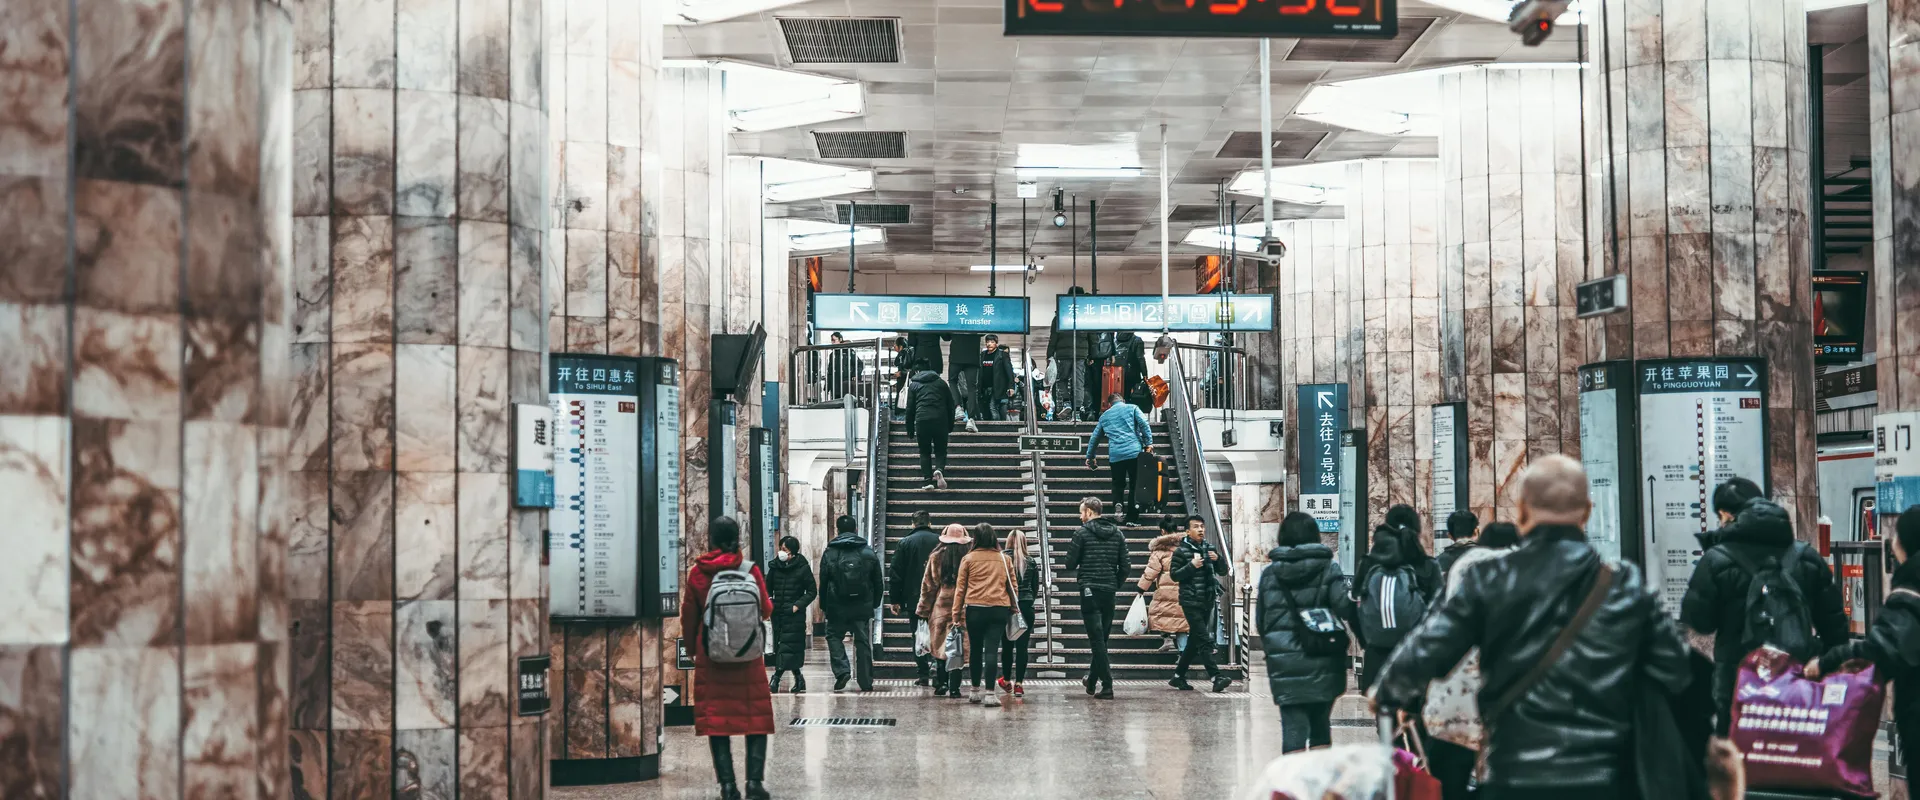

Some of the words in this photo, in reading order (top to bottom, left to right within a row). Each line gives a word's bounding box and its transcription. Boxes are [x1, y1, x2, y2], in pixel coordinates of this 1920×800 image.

[956, 304, 995, 316] 换乘
[1068, 304, 1111, 316] 东北口
[959, 317, 992, 325] Transfer
[557, 367, 635, 383] 开往四惠东
[662, 365, 671, 379] 出
[1594, 369, 1605, 384] 出
[1645, 365, 1729, 382] 开往苹果园
[1584, 373, 1591, 387] C
[1663, 381, 1721, 389] PINGGUOYUAN
[659, 411, 664, 421] A
[1876, 424, 1911, 453] 国门
[1319, 412, 1336, 487] 去往2号线
[660, 488, 664, 498] B
[1306, 498, 1332, 509] 建国
[661, 556, 666, 567] C
